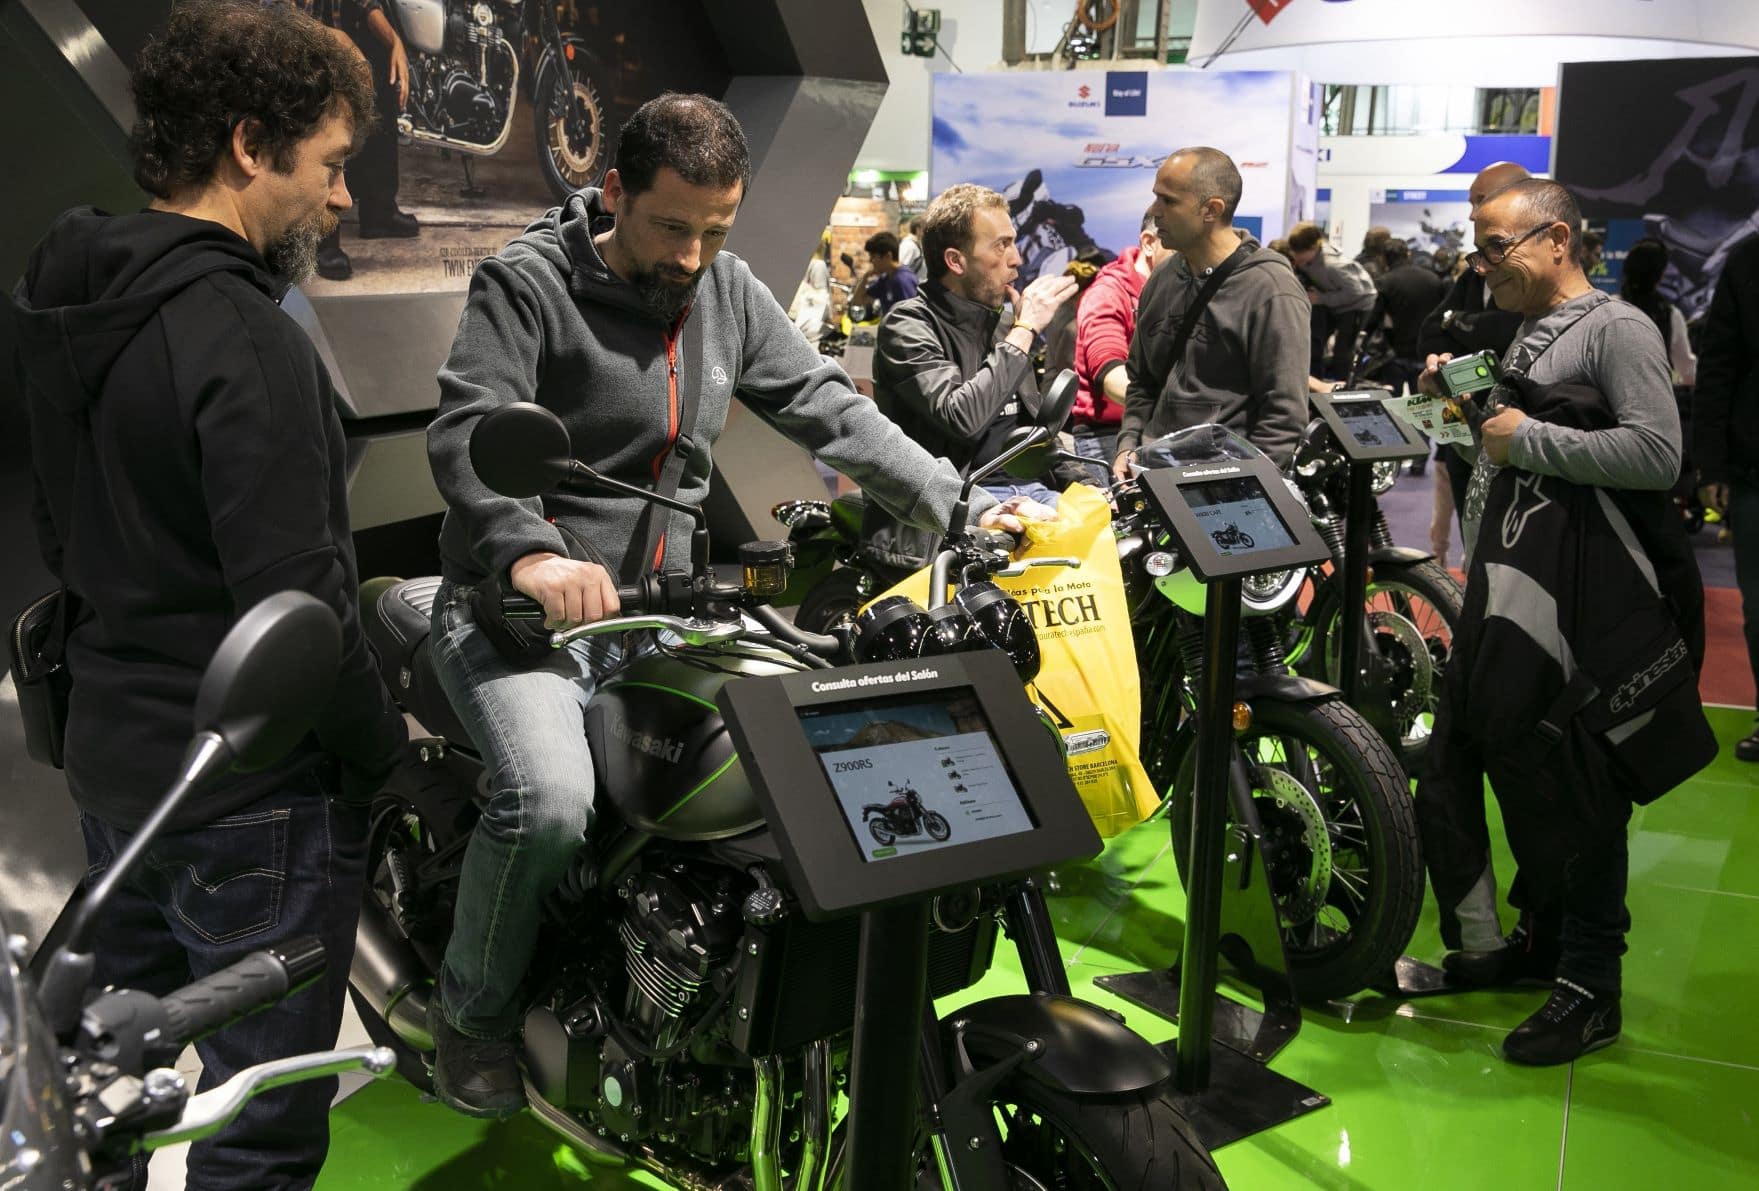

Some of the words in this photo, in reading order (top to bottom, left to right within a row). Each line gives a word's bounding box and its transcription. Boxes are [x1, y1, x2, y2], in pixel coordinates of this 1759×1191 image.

[443, 259, 465, 277] TWIN
[1054, 585, 1064, 593] la
[1067, 582, 1091, 591] Moto
[1021, 594, 1102, 629] TECH
[811, 678, 857, 692] Consulta
[857, 675, 894, 687] ofertas
[894, 671, 910, 682] del
[910, 668, 938, 680] Salón
[1610, 638, 1688, 712] alpinestars
[610, 712, 685, 763] Kawasaki
[833, 758, 873, 773] Z900RS
